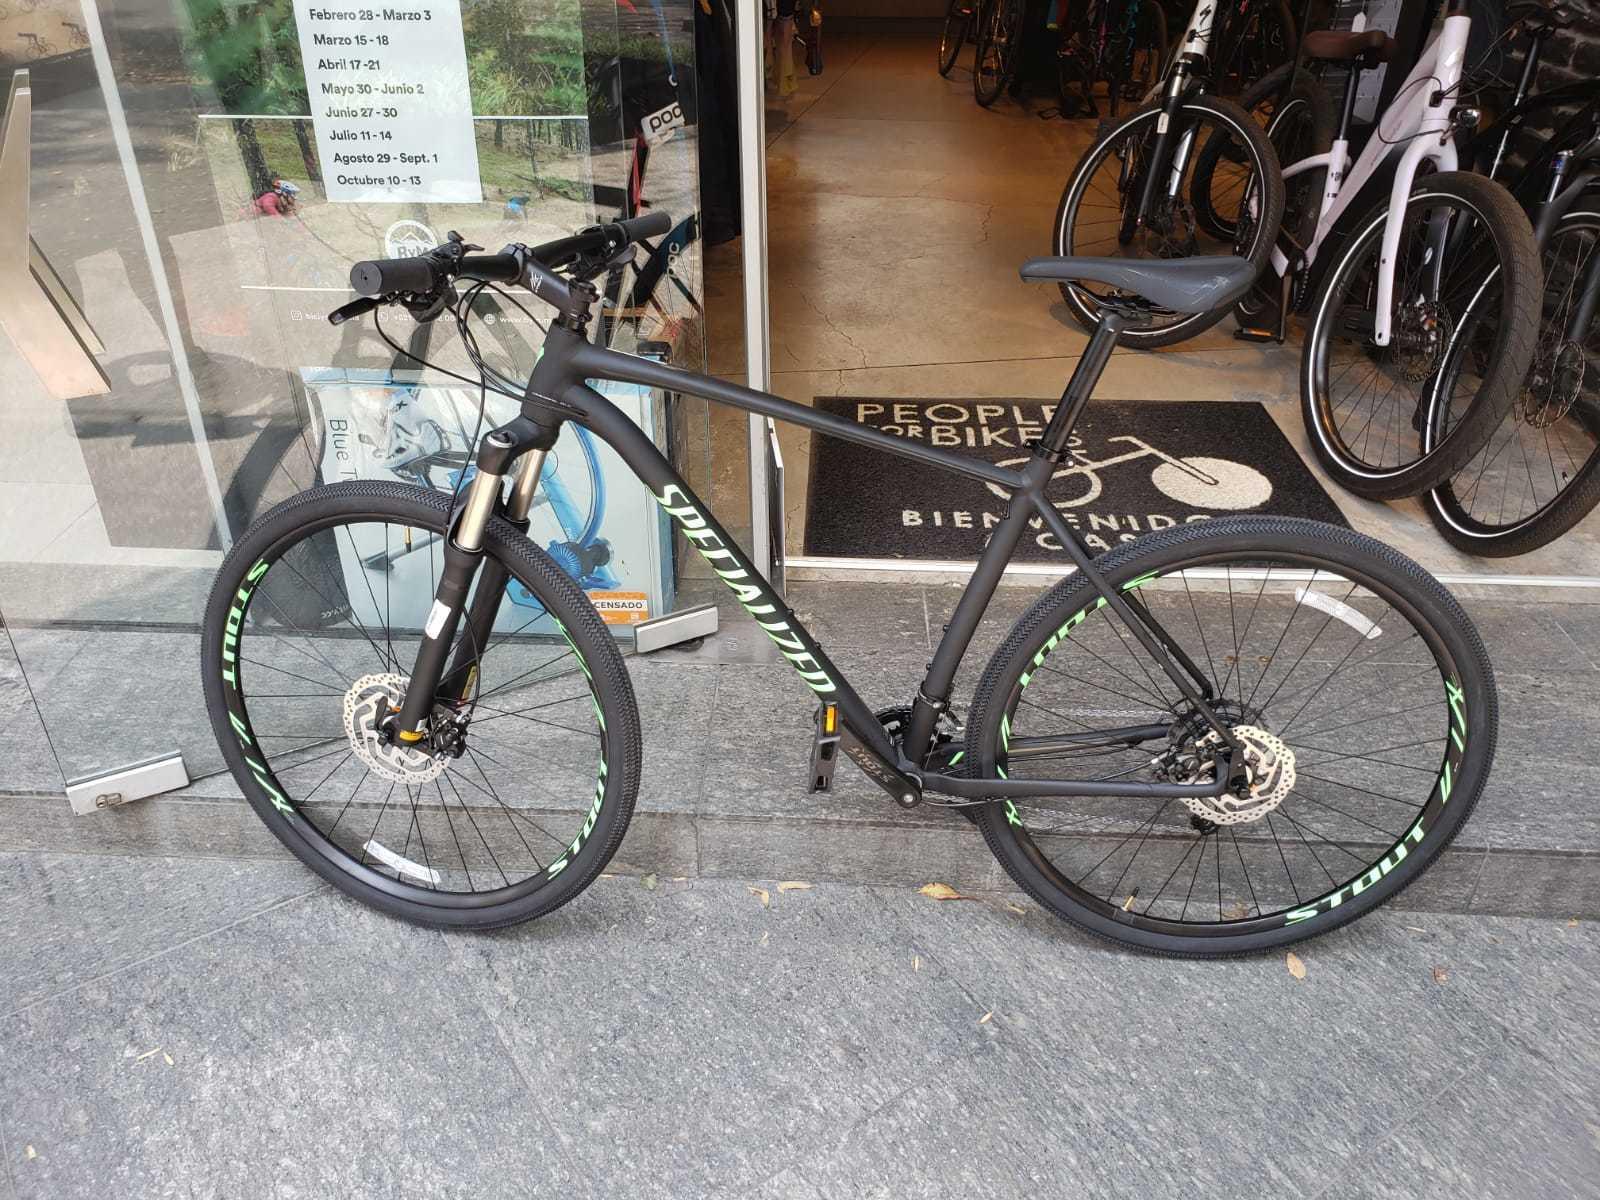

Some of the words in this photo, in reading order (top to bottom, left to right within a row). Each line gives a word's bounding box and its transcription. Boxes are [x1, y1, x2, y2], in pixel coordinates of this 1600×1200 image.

[309, 8, 356, 21] Febrero
[358, 9, 373, 21] 28
[383, 9, 421, 21] Marzo
[424, 10, 432, 21] 3
[313, 34, 352, 46] Marzo
[354, 35, 367, 46] 15
[376, 35, 389, 46] 18
[318, 59, 347, 70] Abril
[349, 60, 361, 70] 17
[321, 83, 354, 97] Mayo
[356, 84, 372, 95] 30
[381, 83, 414, 95] Junio
[416, 84, 424, 95] 2
[326, 107, 358, 118] Junio
[360, 107, 373, 118] 27
[382, 107, 398, 118] 30
[329, 130, 358, 141] Julio
[360, 131, 370, 141] 11
[379, 131, 392, 141] 14
[333, 153, 375, 165] Agosto
[376, 153, 391, 163] 29
[399, 153, 430, 165] Sept.
[433, 153, 438, 163] 1
[337, 175, 385, 185] Octubre
[387, 176, 400, 185] 10
[409, 176, 421, 185] 13
[868, 424, 925, 438] OR
[328, 419, 349, 461] Blue
[655, 484, 837, 692] SPECIALIZED
[222, 558, 269, 690] STOUT
[1284, 816, 1425, 926] STOUT
